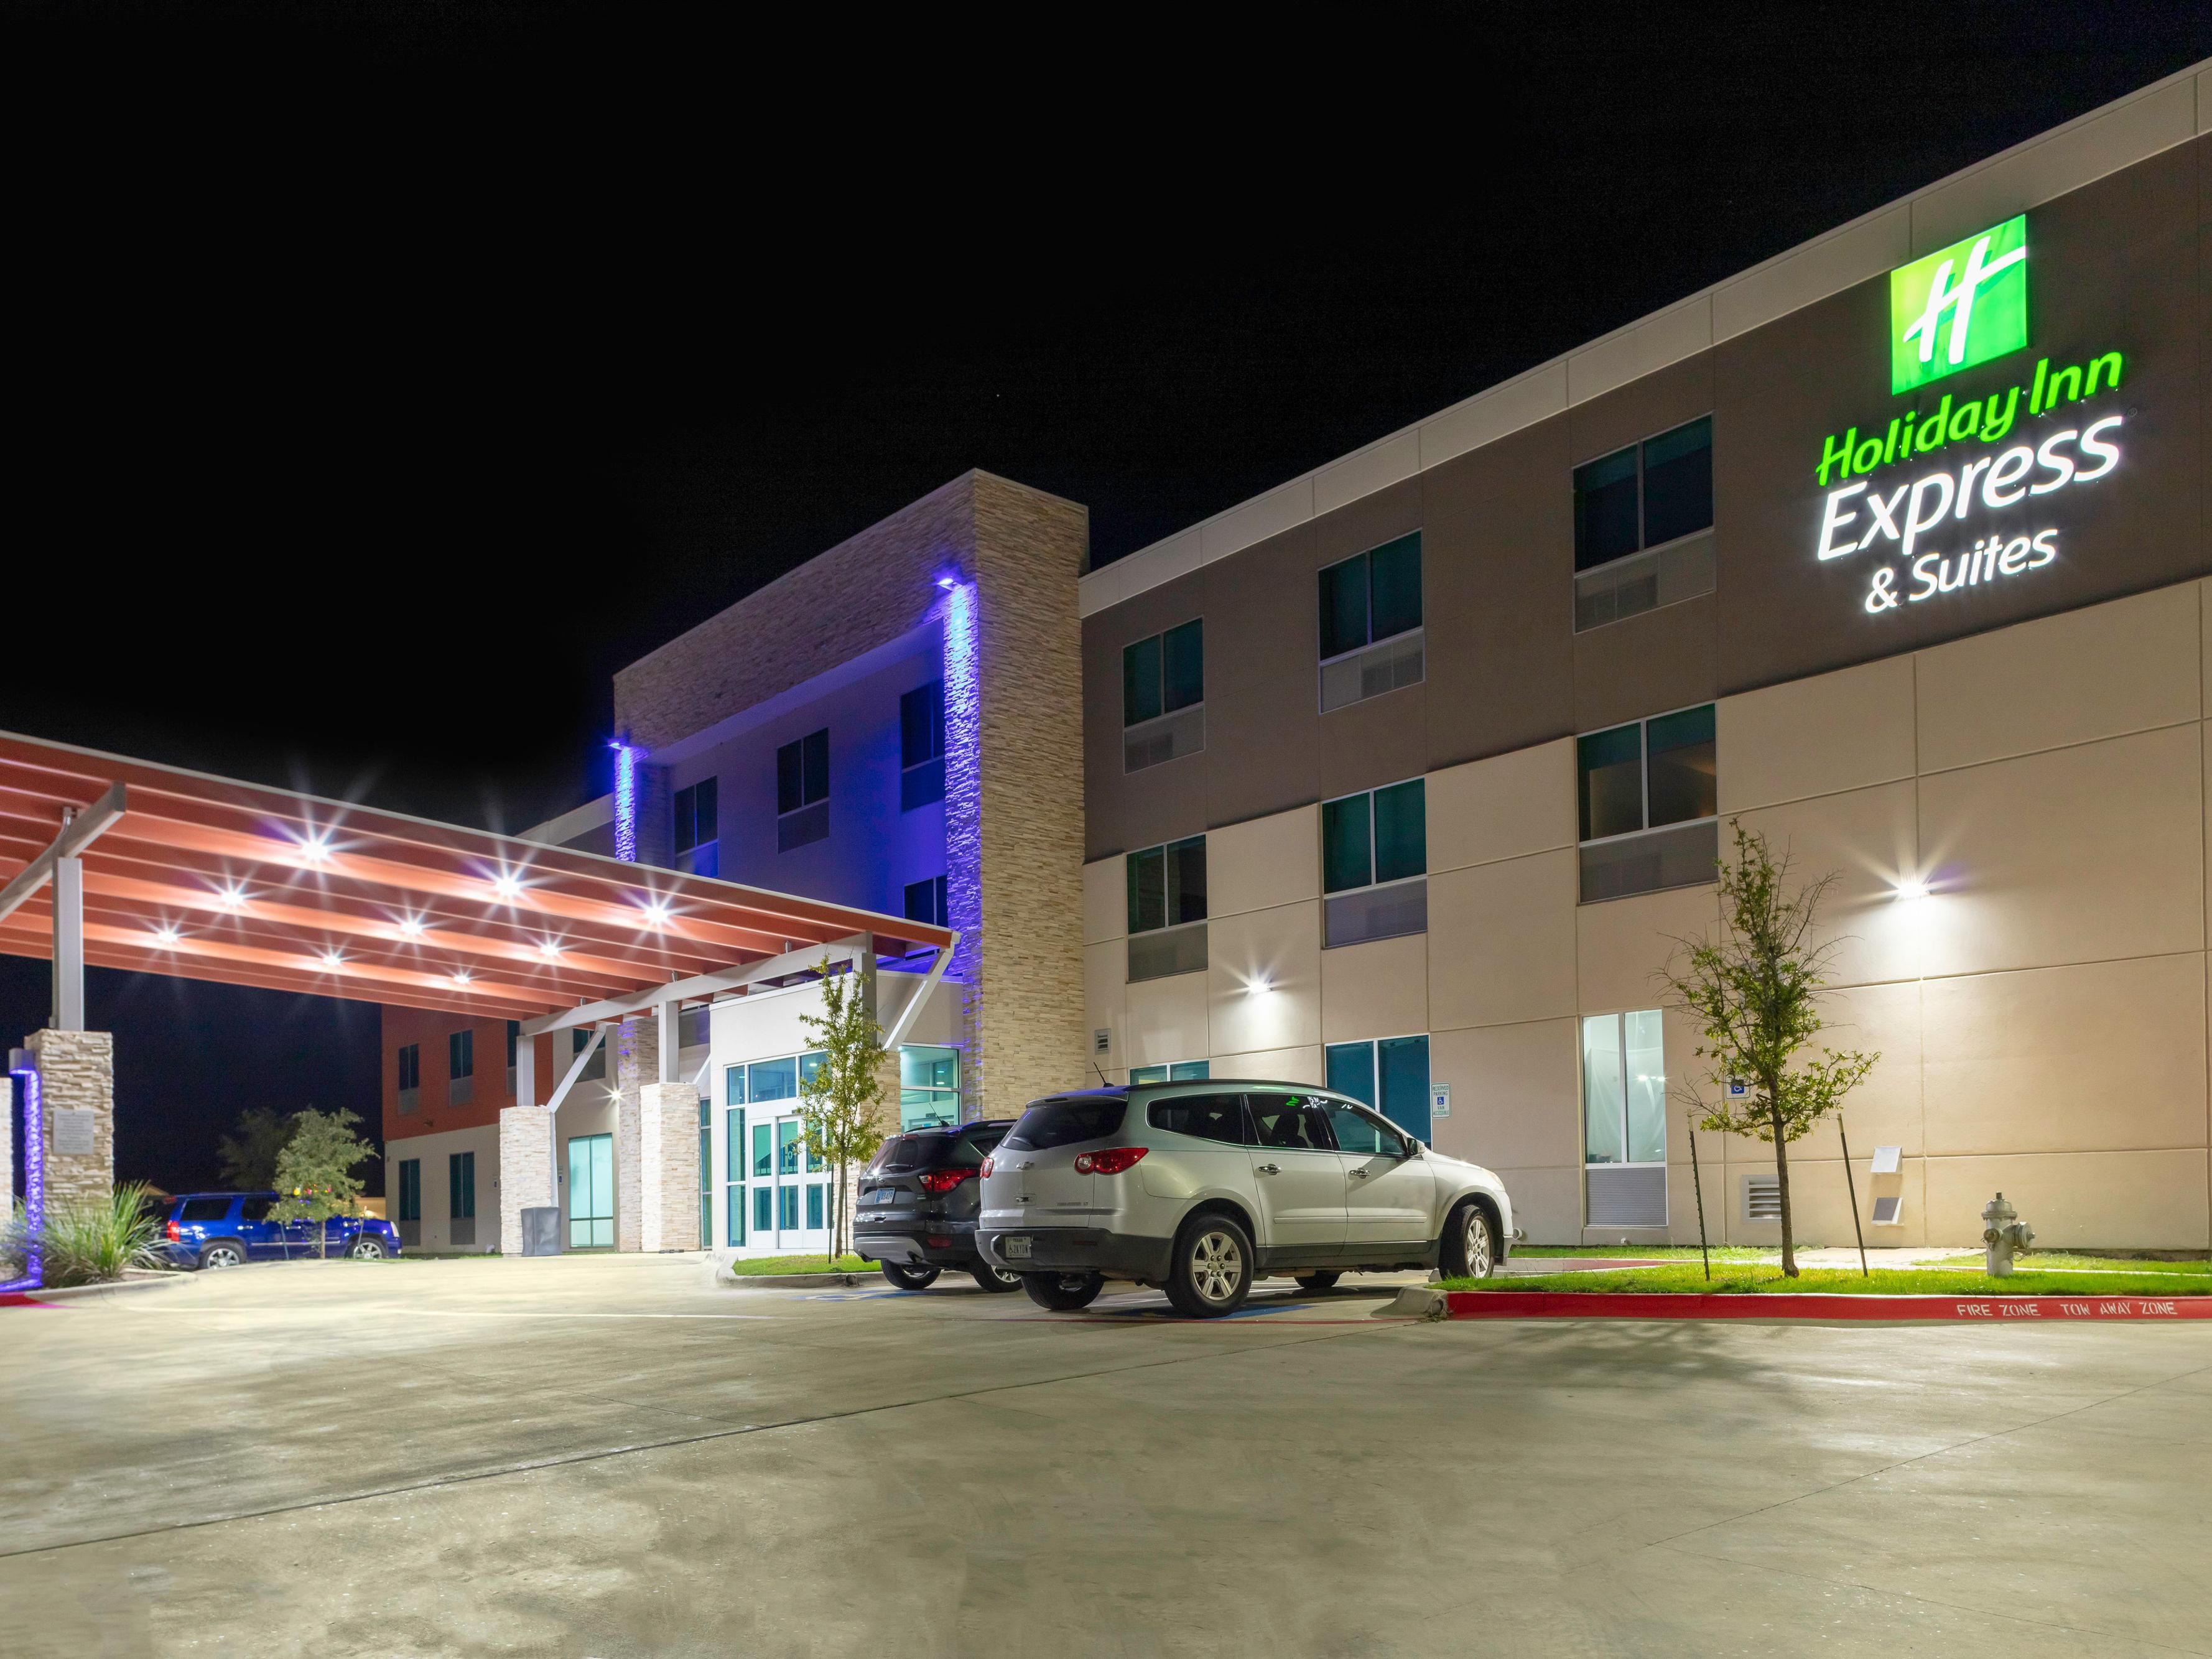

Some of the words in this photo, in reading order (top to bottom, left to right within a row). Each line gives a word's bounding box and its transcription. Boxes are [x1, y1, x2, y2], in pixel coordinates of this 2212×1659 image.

[1815, 386, 2020, 486] Holiday
[2029, 351, 2122, 414] Inn
[1818, 416, 2123, 560] Express
[1865, 567, 1898, 613] &
[1908, 529, 2058, 602] Suites
[1956, 1304, 1993, 1316] FIRE
[1999, 1304, 2041, 1316] ZONE
[2060, 1303, 2091, 1316] TOW
[2099, 1302, 2132, 1314] AWAY
[2139, 1302, 2178, 1314] ZONE
